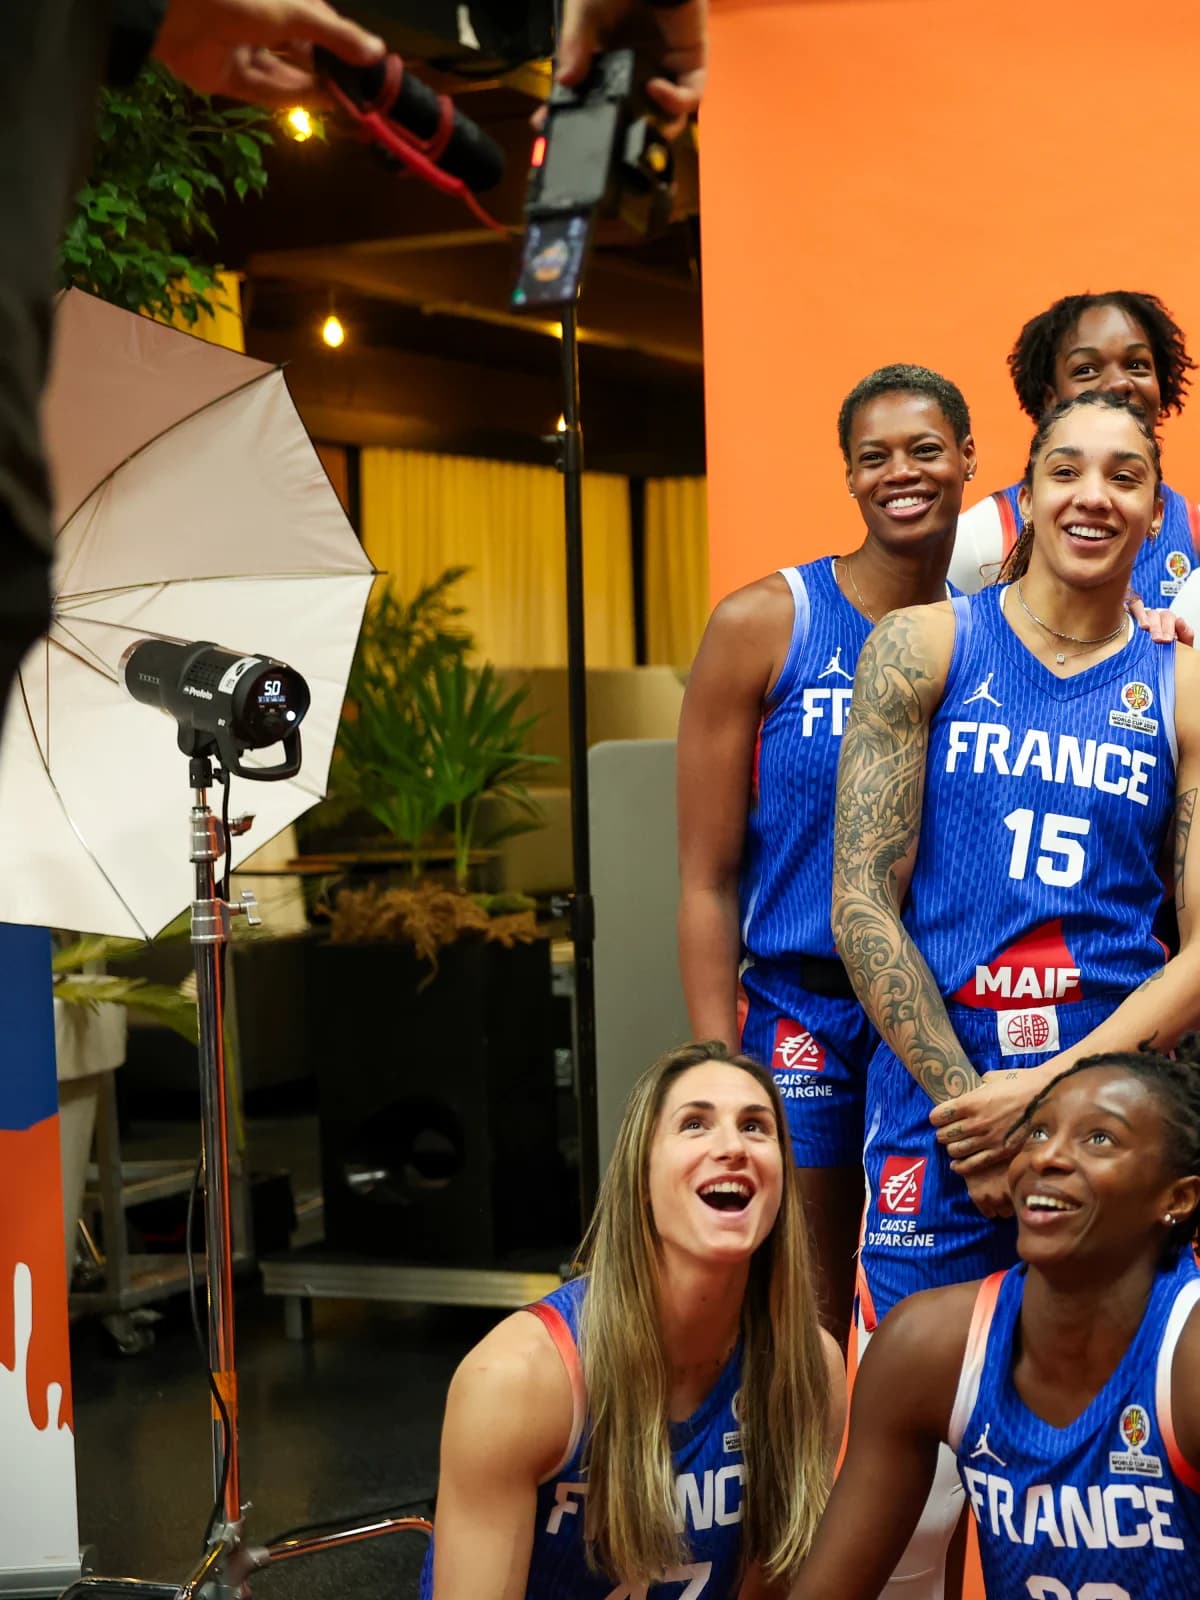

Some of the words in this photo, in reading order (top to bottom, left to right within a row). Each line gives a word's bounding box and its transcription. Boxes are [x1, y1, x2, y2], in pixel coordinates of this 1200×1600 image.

[189, 686, 213, 701] Profoto
[945, 721, 1157, 806] FRANCE
[1003, 807, 1091, 888] 15
[975, 965, 1081, 999] MAIF
[1024, 1014, 1034, 1047] FRA
[773, 1073, 818, 1086] CAISSE
[779, 1084, 833, 1099] PARGNE
[880, 1218, 917, 1233] CAISSE
[963, 1466, 1185, 1551] FRANCE
